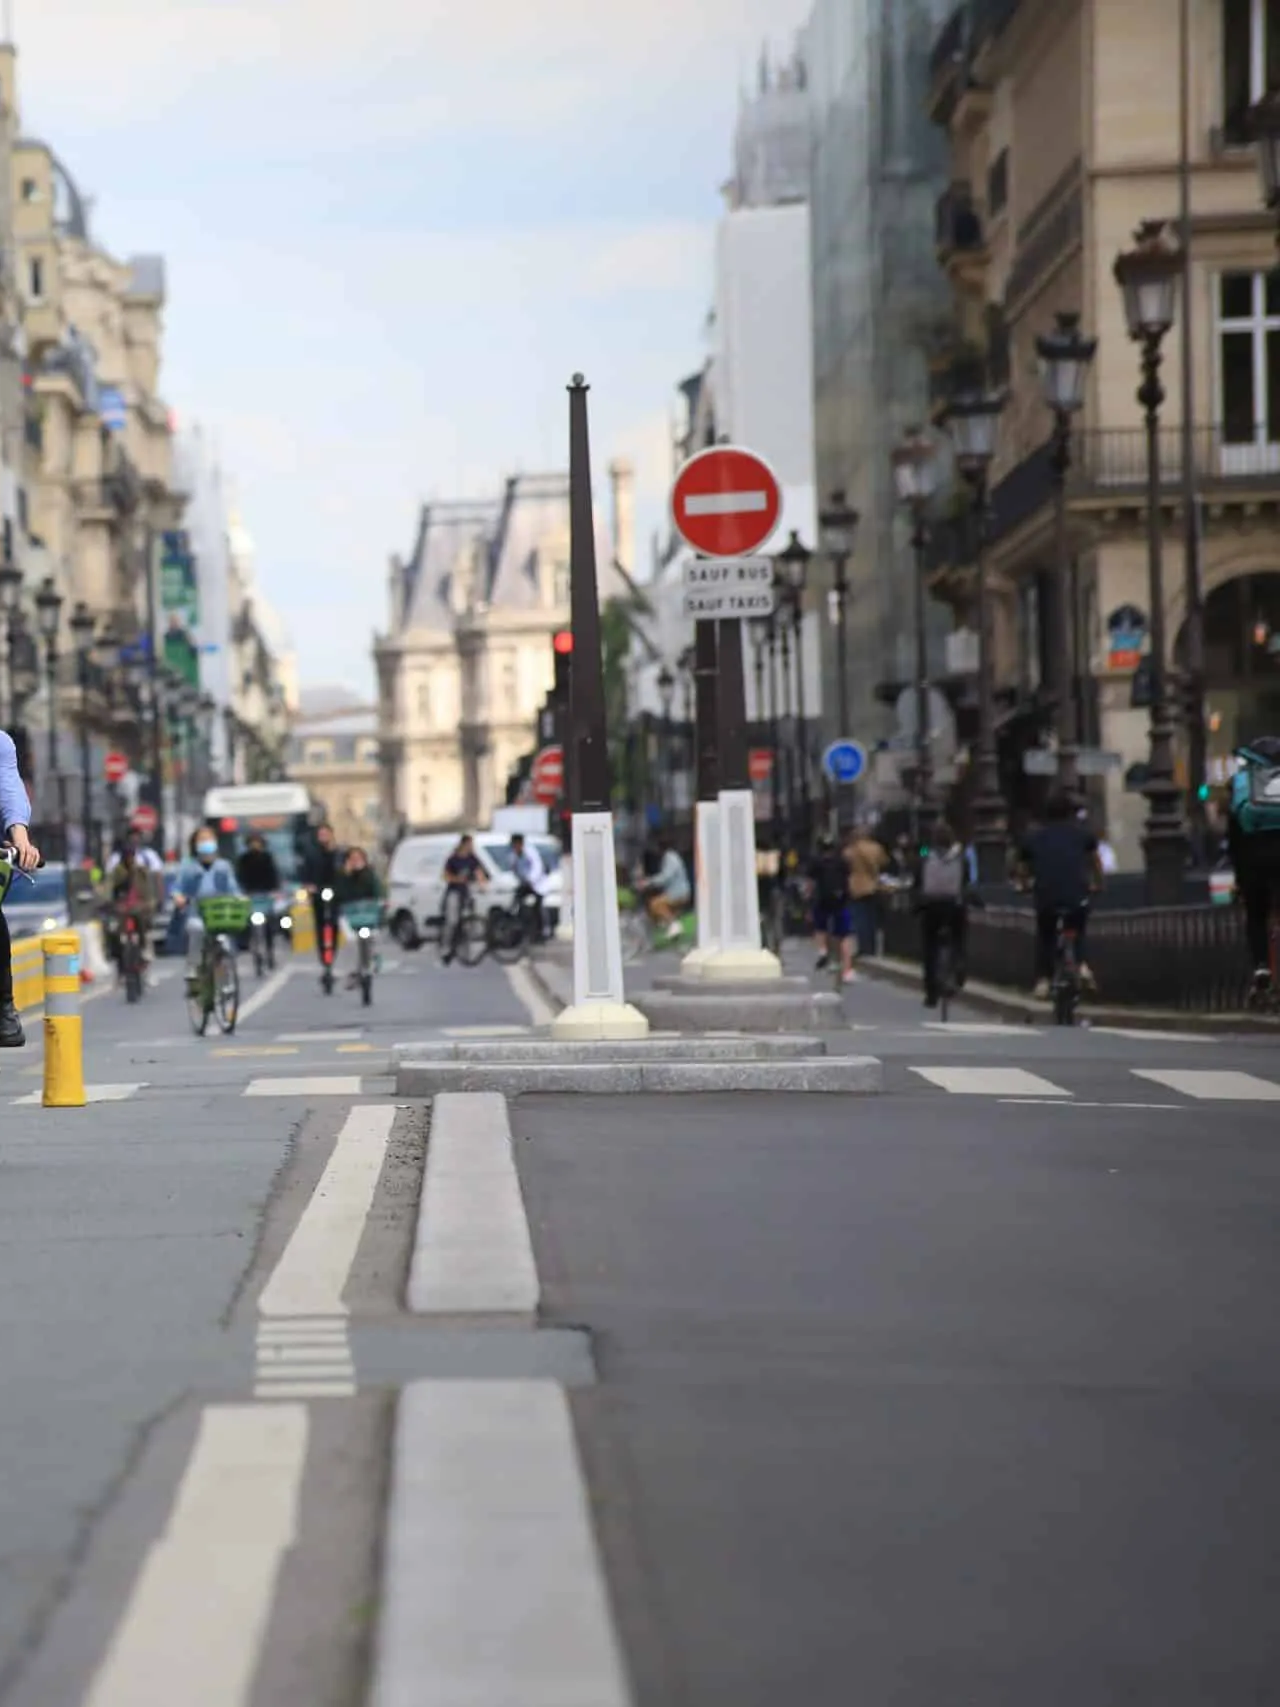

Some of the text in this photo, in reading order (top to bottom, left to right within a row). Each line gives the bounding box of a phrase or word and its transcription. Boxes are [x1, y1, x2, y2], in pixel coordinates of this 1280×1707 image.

[689, 566, 769, 582] SAUF BUS
[687, 596, 770, 611] SAUF TAXIS
